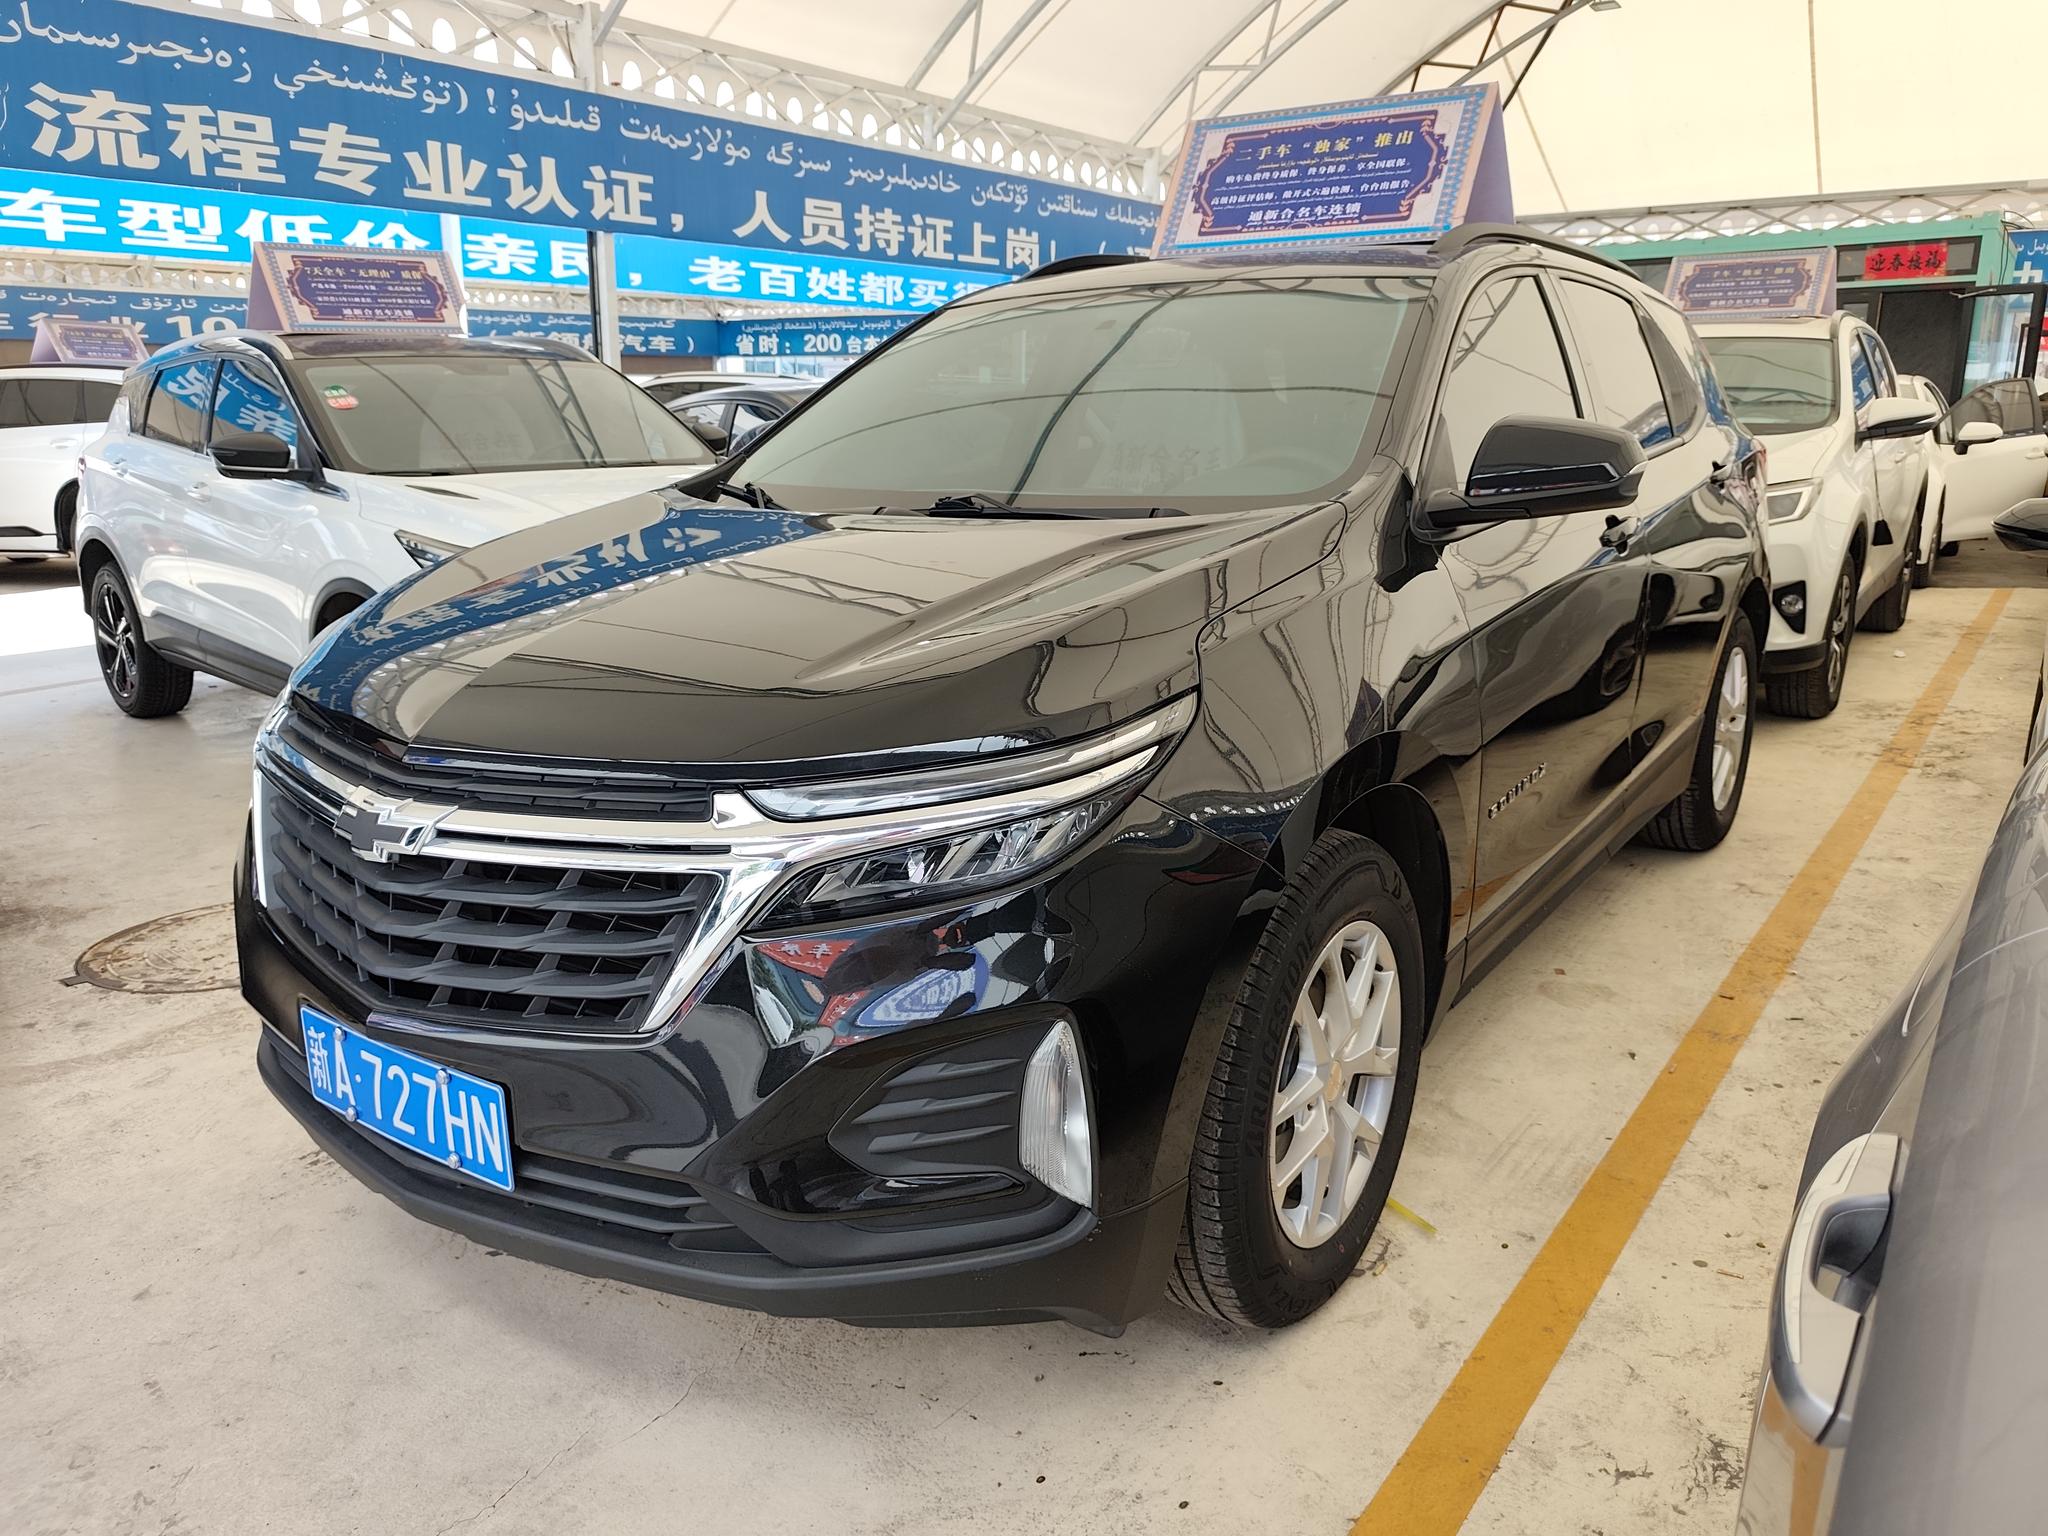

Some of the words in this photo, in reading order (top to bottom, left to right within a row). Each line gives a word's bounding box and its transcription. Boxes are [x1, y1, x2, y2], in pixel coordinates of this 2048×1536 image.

[620, 117, 751, 166] مۇلازىمەت
[766, 141, 831, 177] سىزگە
[1869, 250, 1942, 272] 迎春接福
